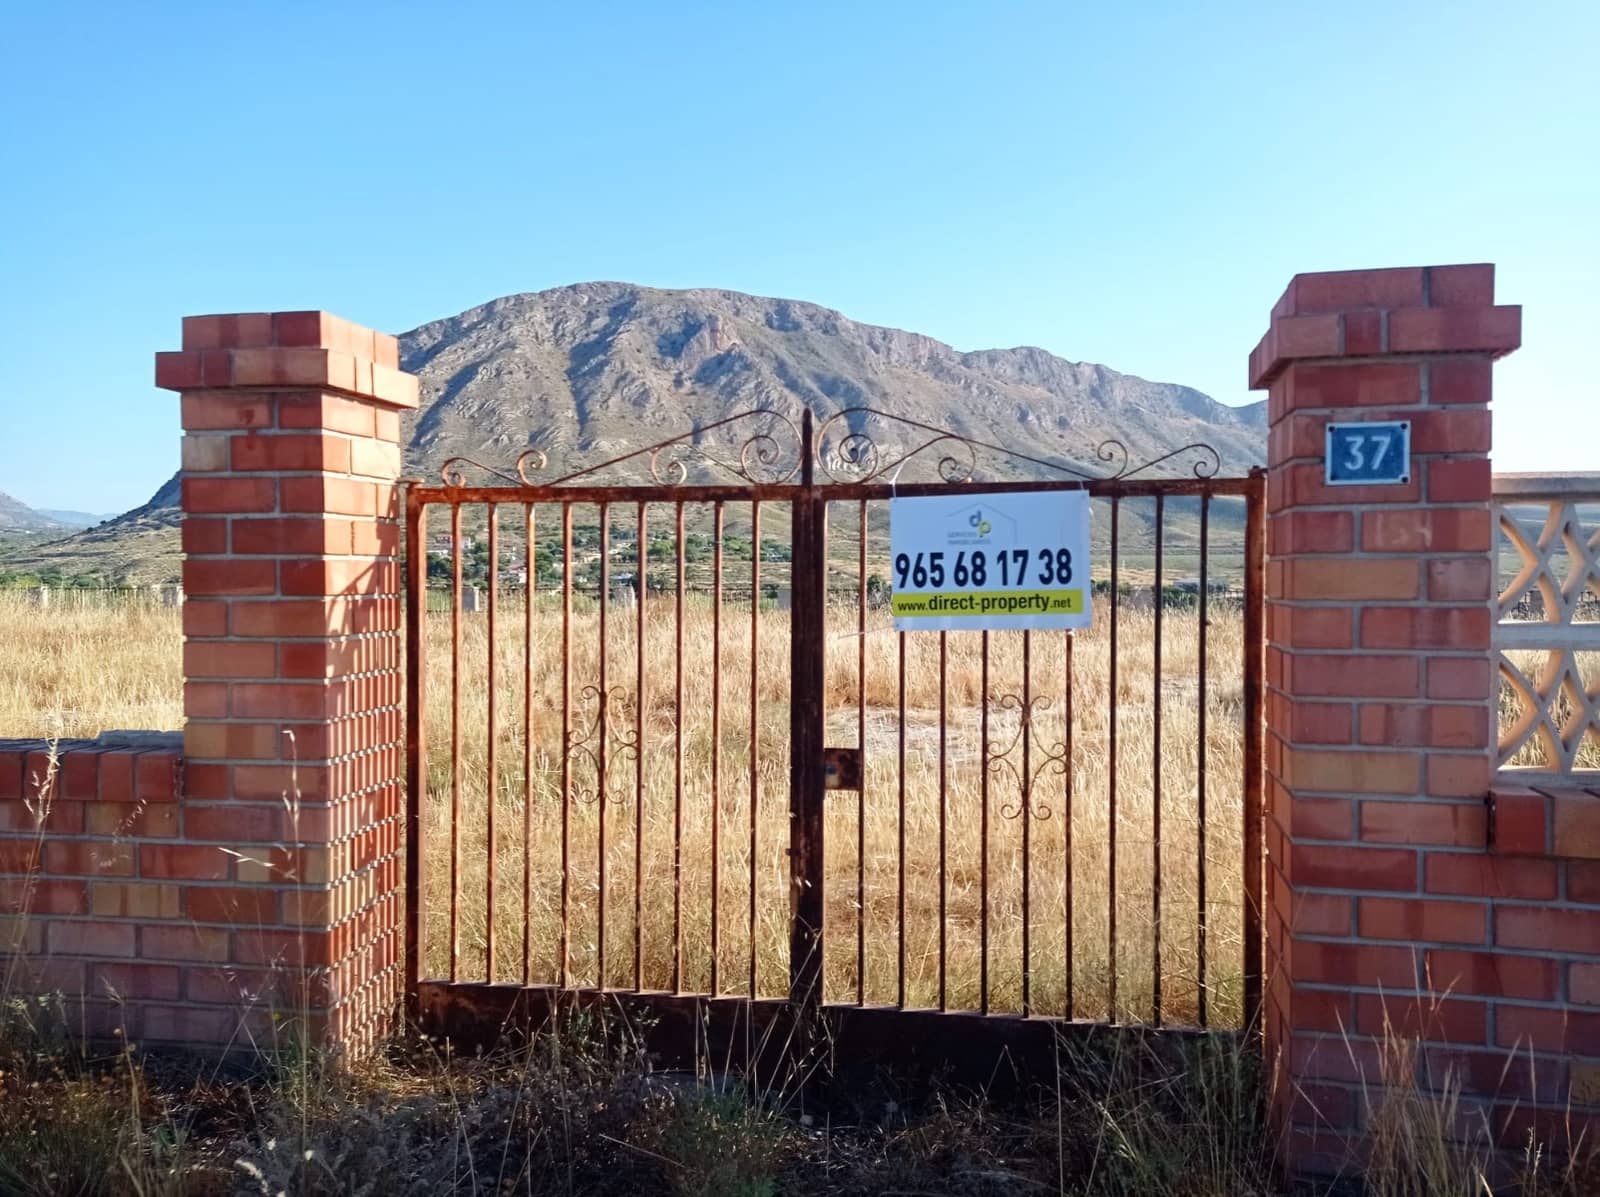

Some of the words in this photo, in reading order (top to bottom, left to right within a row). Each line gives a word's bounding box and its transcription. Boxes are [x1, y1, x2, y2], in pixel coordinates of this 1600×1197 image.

[1344, 434, 1391, 470] 37
[895, 552, 945, 589] 965
[954, 551, 987, 587] 68
[997, 549, 1029, 586] 17
[1038, 548, 1073, 585] 38
[897, 593, 1071, 612] www.direct-property.net
